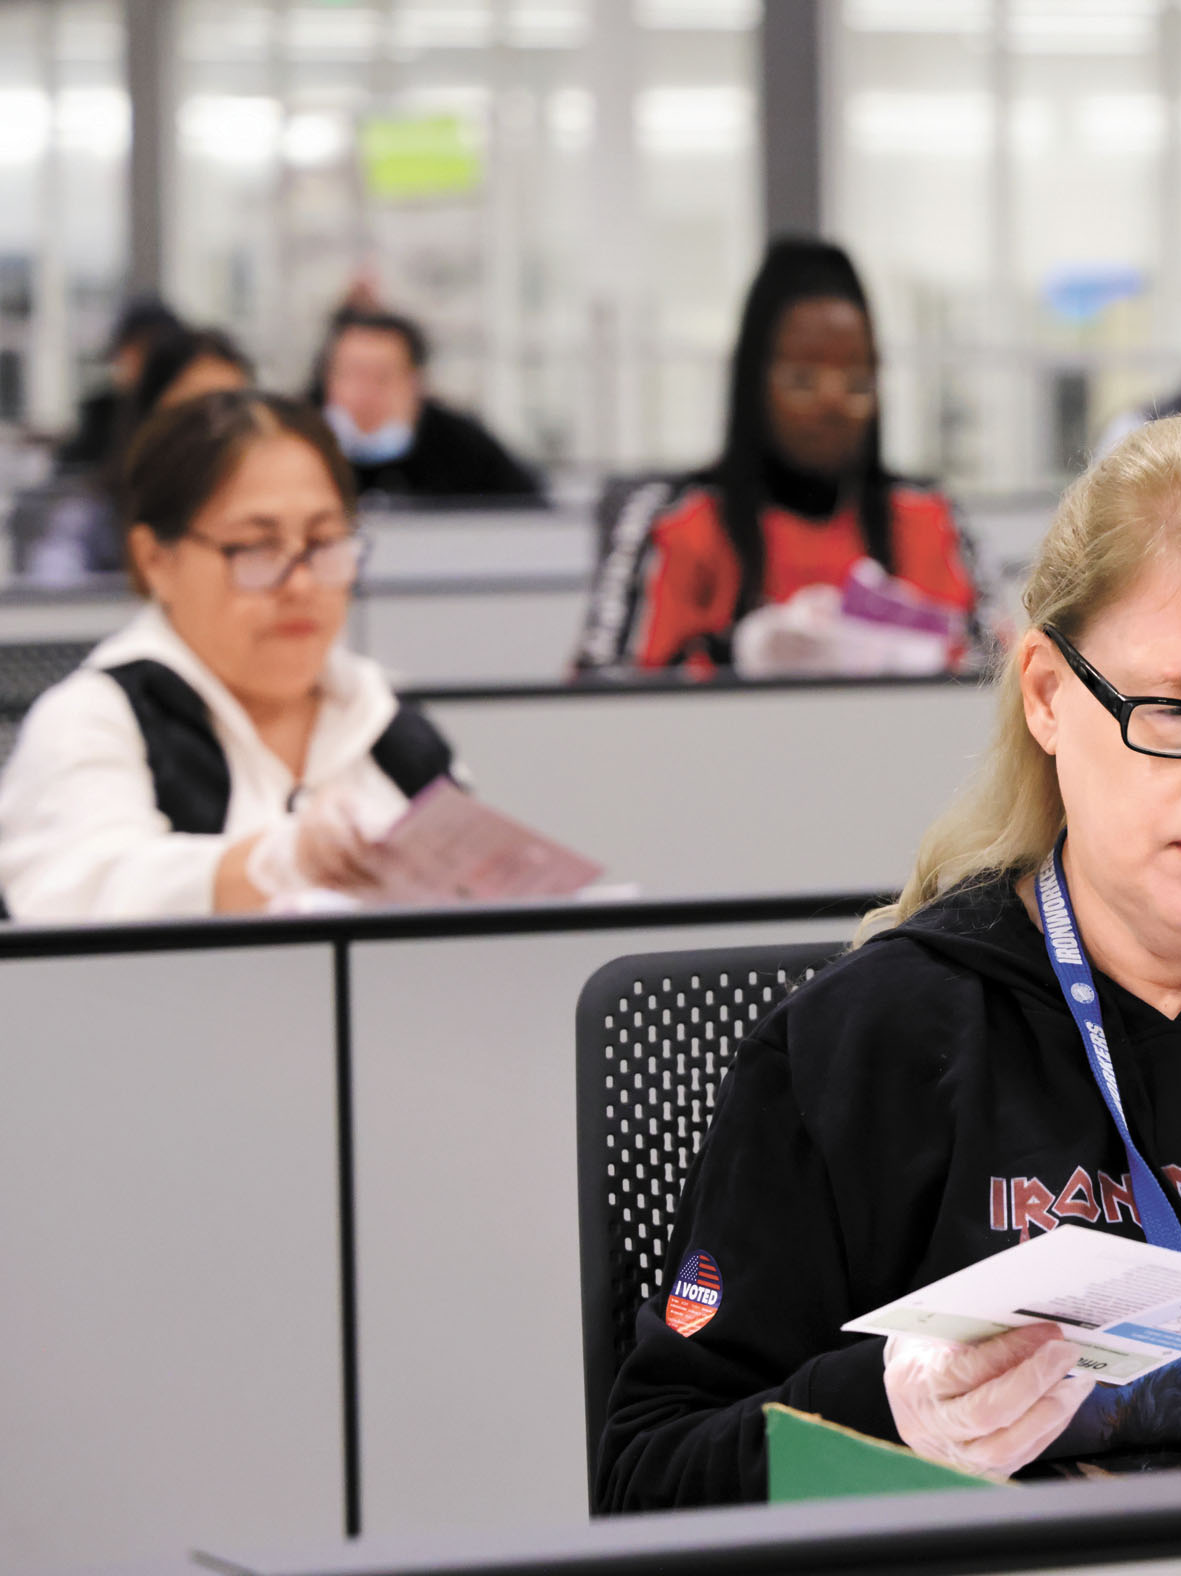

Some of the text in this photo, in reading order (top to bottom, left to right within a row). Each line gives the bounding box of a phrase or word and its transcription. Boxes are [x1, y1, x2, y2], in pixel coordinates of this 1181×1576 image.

[990, 1166, 1143, 1240] IRON
[675, 1280, 718, 1306] I VOTED
